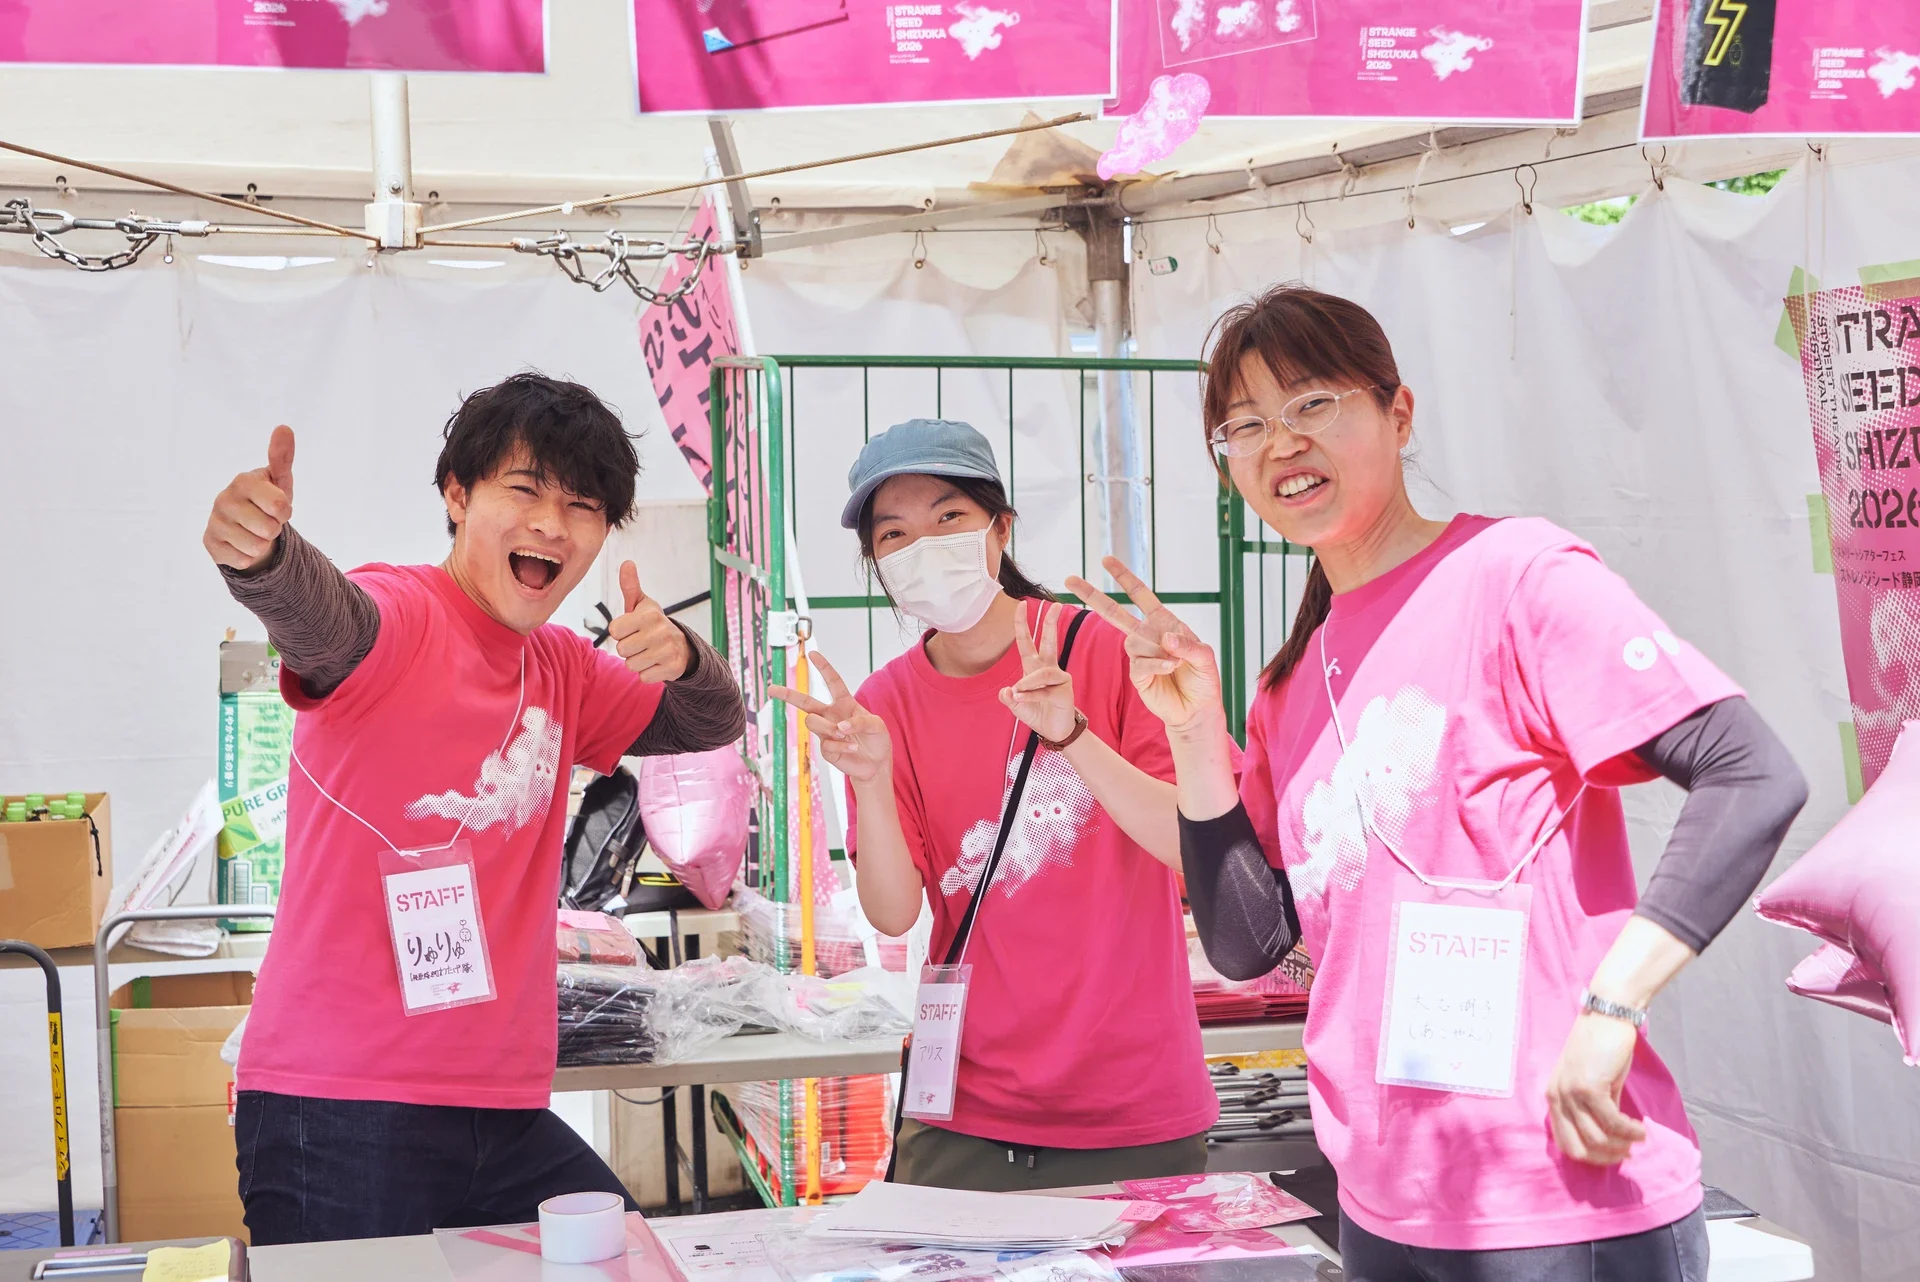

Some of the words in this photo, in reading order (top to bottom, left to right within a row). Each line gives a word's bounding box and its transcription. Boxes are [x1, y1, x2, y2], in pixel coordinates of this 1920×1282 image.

[894, 5, 942, 16] STRANGE
[895, 17, 923, 28] SEED
[895, 28, 947, 40] SHIZUOKA
[1369, 27, 1417, 37] STRANGE
[896, 41, 923, 52] 2026
[1368, 38, 1395, 48] SEED
[1367, 49, 1418, 60] SHIZUOKA
[1820, 48, 1865, 58] STRANGE
[1366, 60, 1392, 70] 2026
[1819, 58, 1846, 68] SEED
[1818, 69, 1867, 79] SHIZUOKA
[1818, 79, 1843, 89] 2026
[1817, 316, 1836, 390] STREET
[222, 794, 264, 822] PURE
[396, 885, 465, 912] STAFF
[1409, 931, 1511, 960] STAFF
[920, 1003, 958, 1021] STAFF
[919, 1046, 943, 1062] アリス
